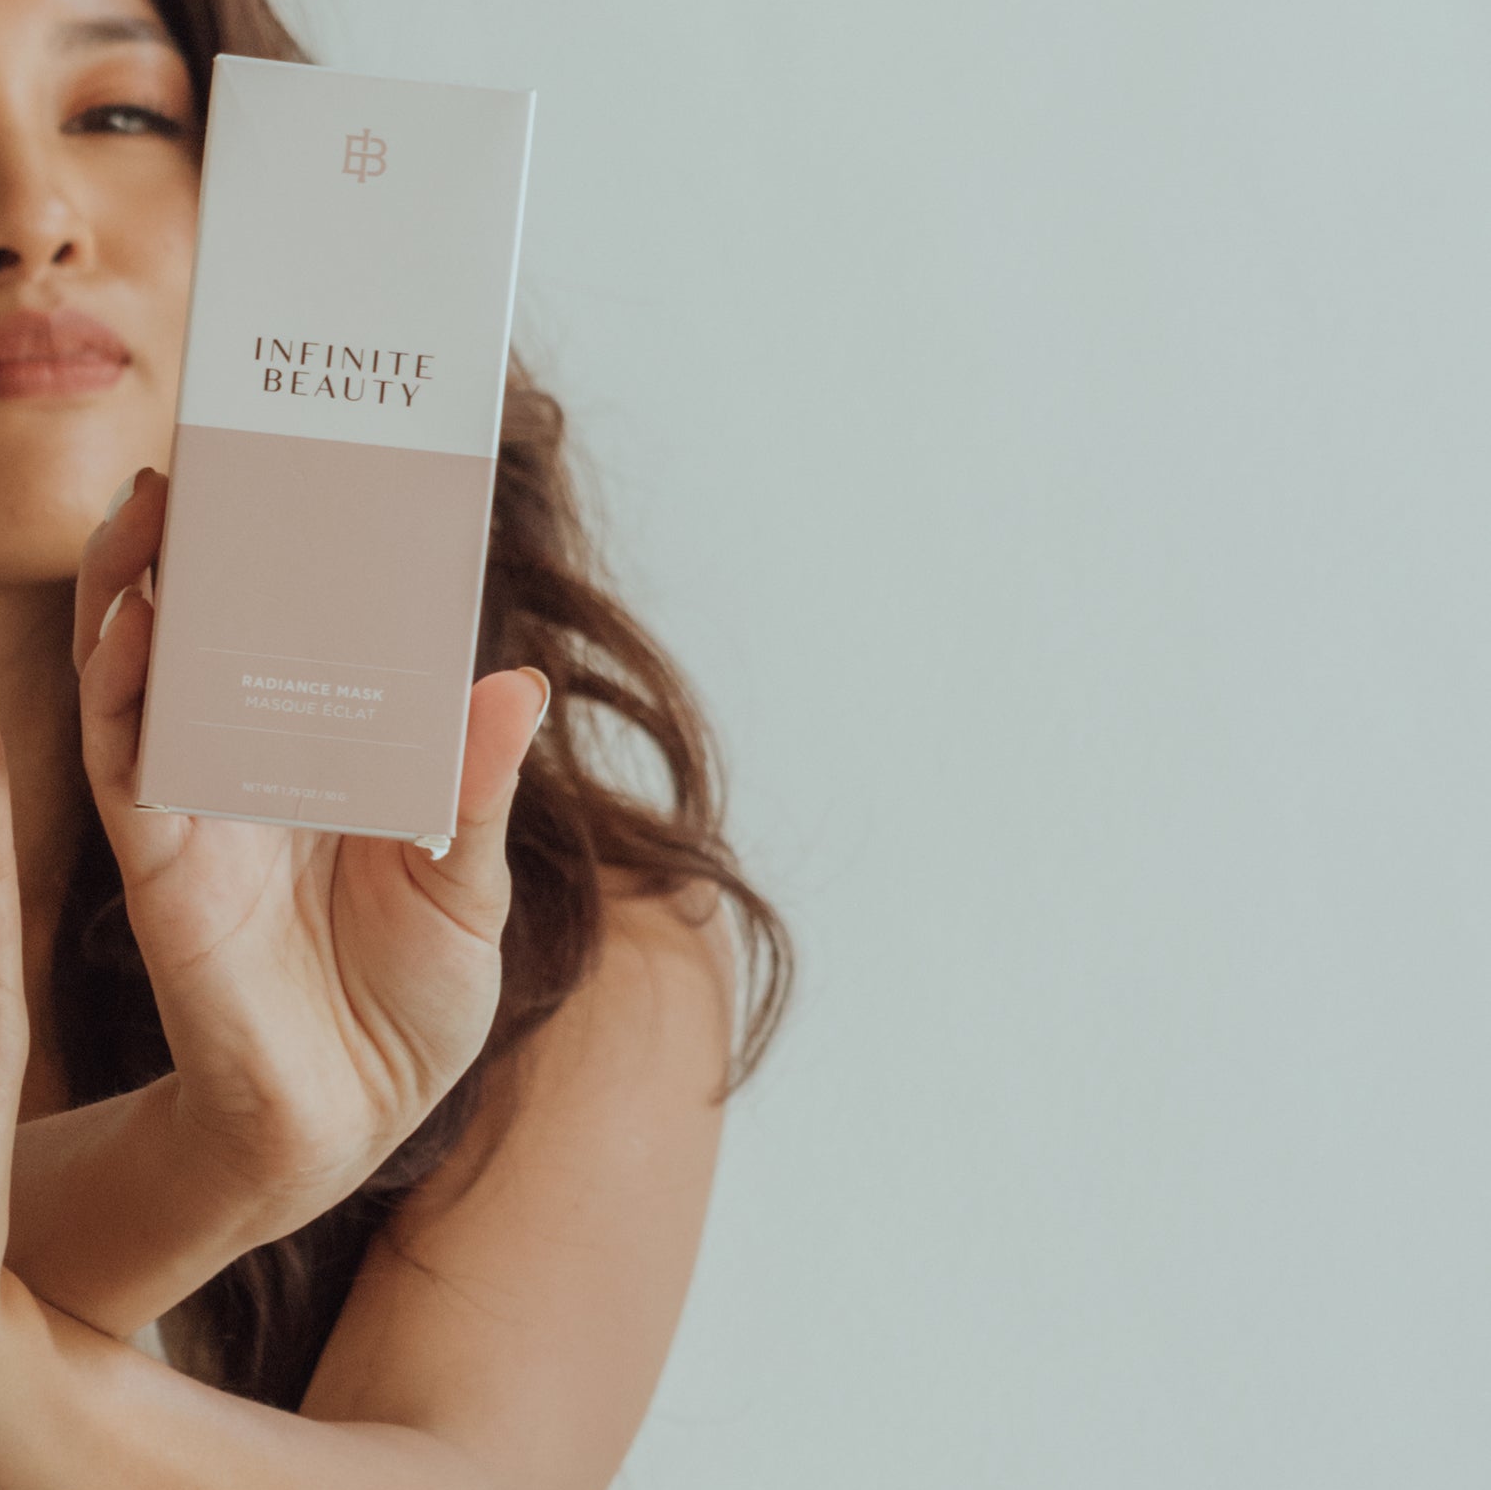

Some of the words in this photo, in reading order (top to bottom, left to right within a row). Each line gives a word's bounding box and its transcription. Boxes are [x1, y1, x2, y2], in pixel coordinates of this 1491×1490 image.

[255, 337, 435, 380] INFINITE
[263, 368, 420, 407] BEAUTY
[242, 674, 331, 696] RADIANCE
[336, 685, 384, 701] MASK
[245, 696, 317, 715] MASQUE
[323, 701, 375, 720] ÉCLAT
